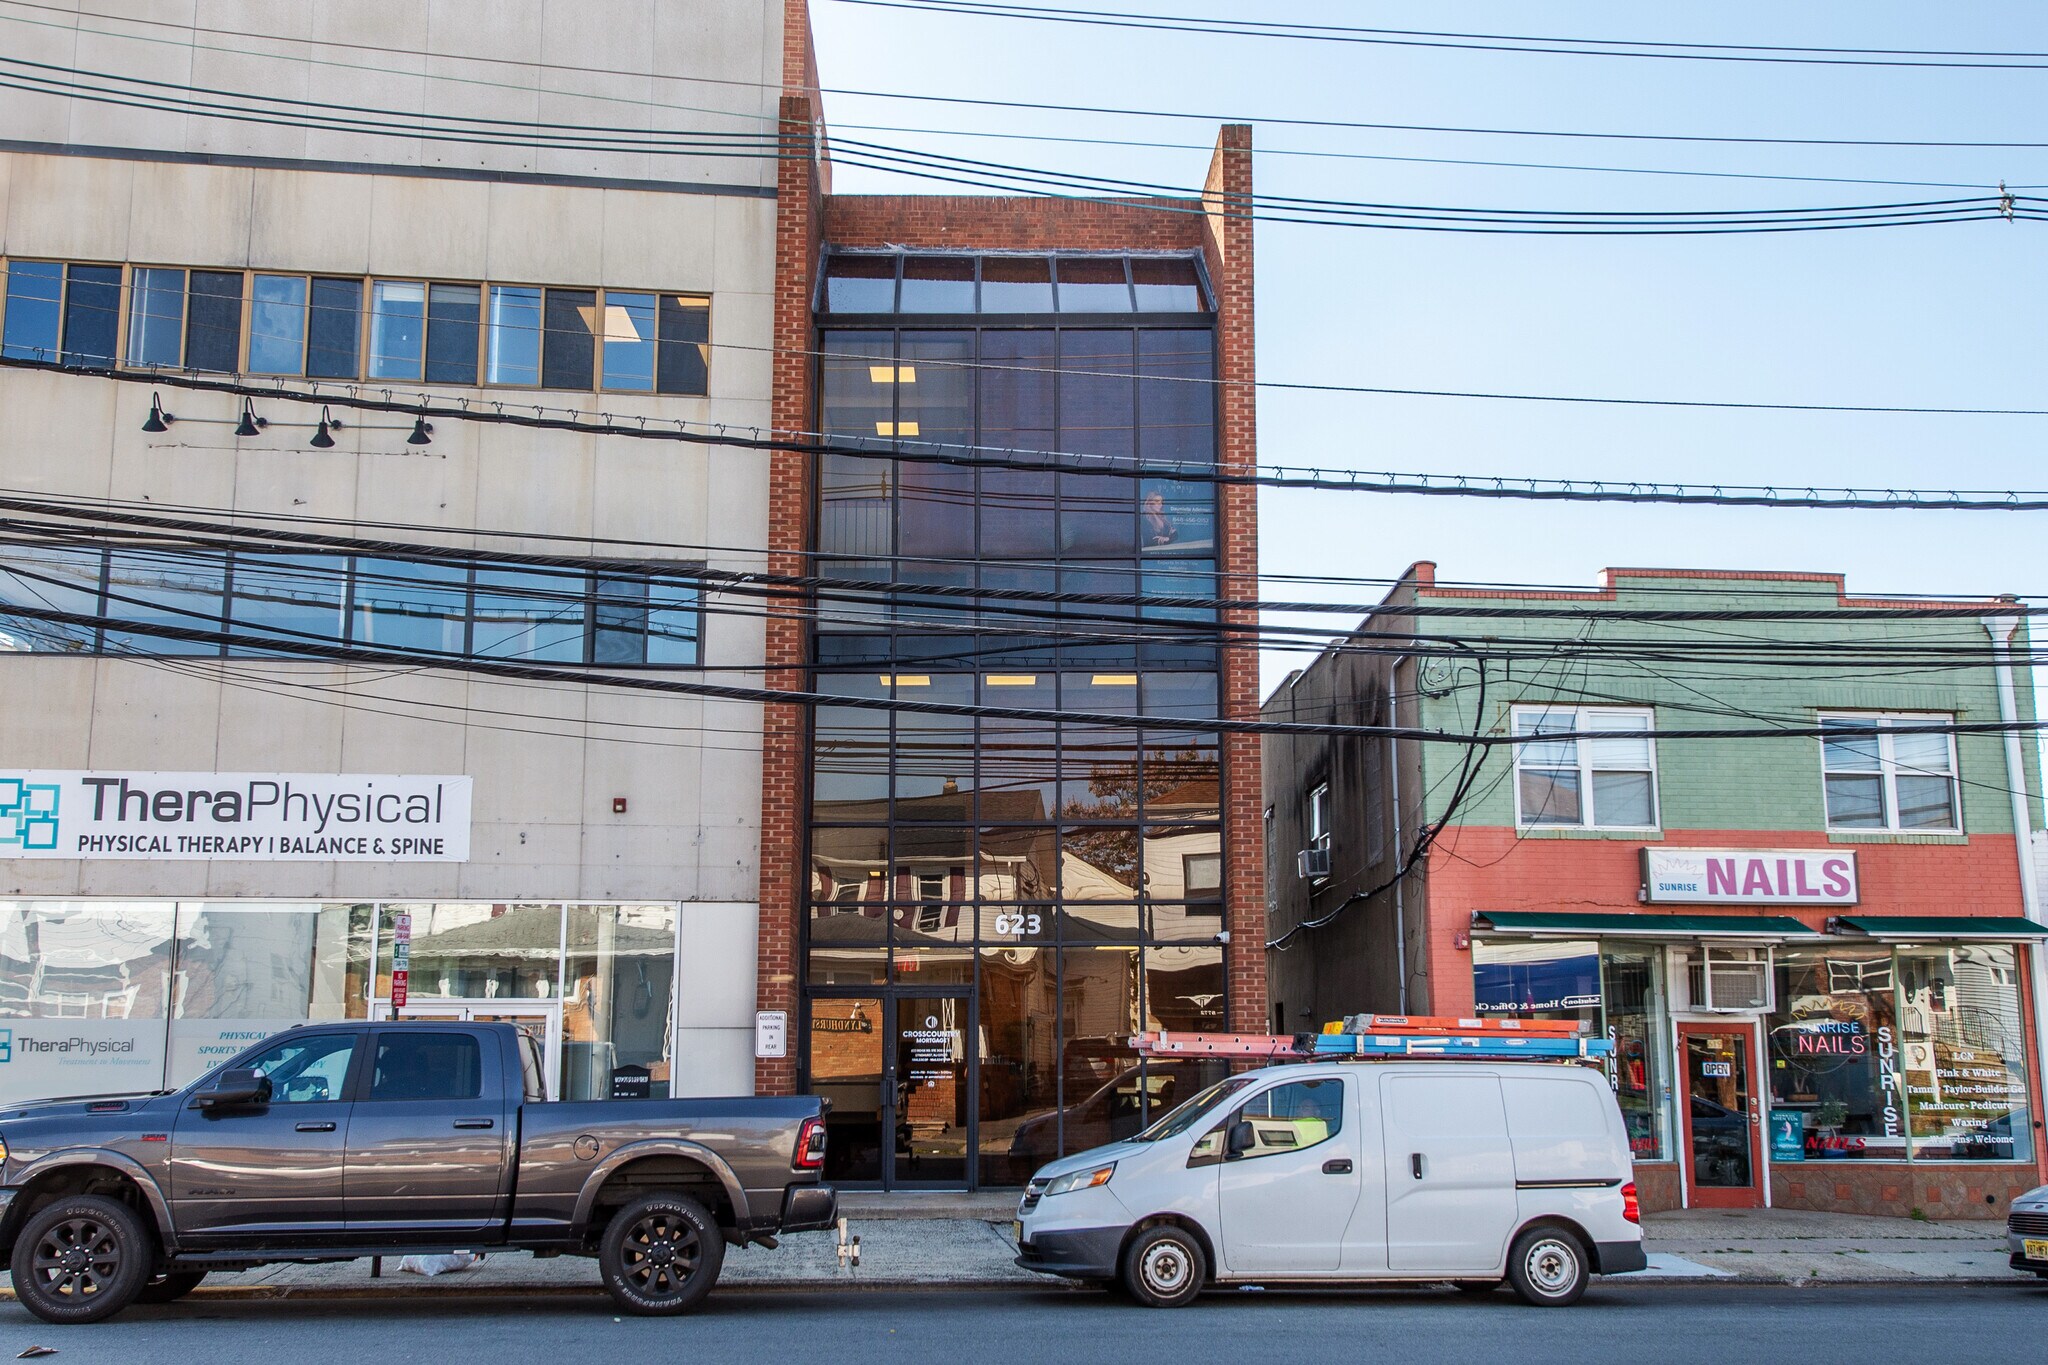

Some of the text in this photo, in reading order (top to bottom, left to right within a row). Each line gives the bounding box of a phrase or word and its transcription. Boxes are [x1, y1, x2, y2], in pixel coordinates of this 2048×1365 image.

[82, 777, 442, 834] TheraPhysical
[78, 835, 172, 853] PHYSICAL
[178, 836, 263, 854] THERAPY
[281, 837, 367, 855] BALANCE
[373, 838, 386, 855] &
[391, 838, 444, 855] SPINE
[1658, 858, 1851, 897] SUNRISE NAILS
[995, 914, 1041, 935] 623
[1798, 1021, 1860, 1034] SUNRISE
[219, 1031, 267, 1040] PHYSICAL
[902, 1030, 960, 1038] CROSSCOUNTRY
[18, 1037, 135, 1056] TheraPhysical
[198, 1045, 237, 1054] SPORTS
[1798, 1035, 1865, 1054] NAILS
[59, 1057, 98, 1065] Treatment
[110, 1057, 151, 1065] Movement
[1953, 1052, 1975, 1060] LCN
[1705, 1063, 1729, 1075] OPEN
[1936, 1068, 2001, 1077] Pink & White
[1878, 1026, 1899, 1138] SUNRISE
[1951, 1118, 1988, 1128] Waxing
[1805, 1135, 1867, 1150] NAILS
[1975, 1134, 2014, 1144] Welcome
